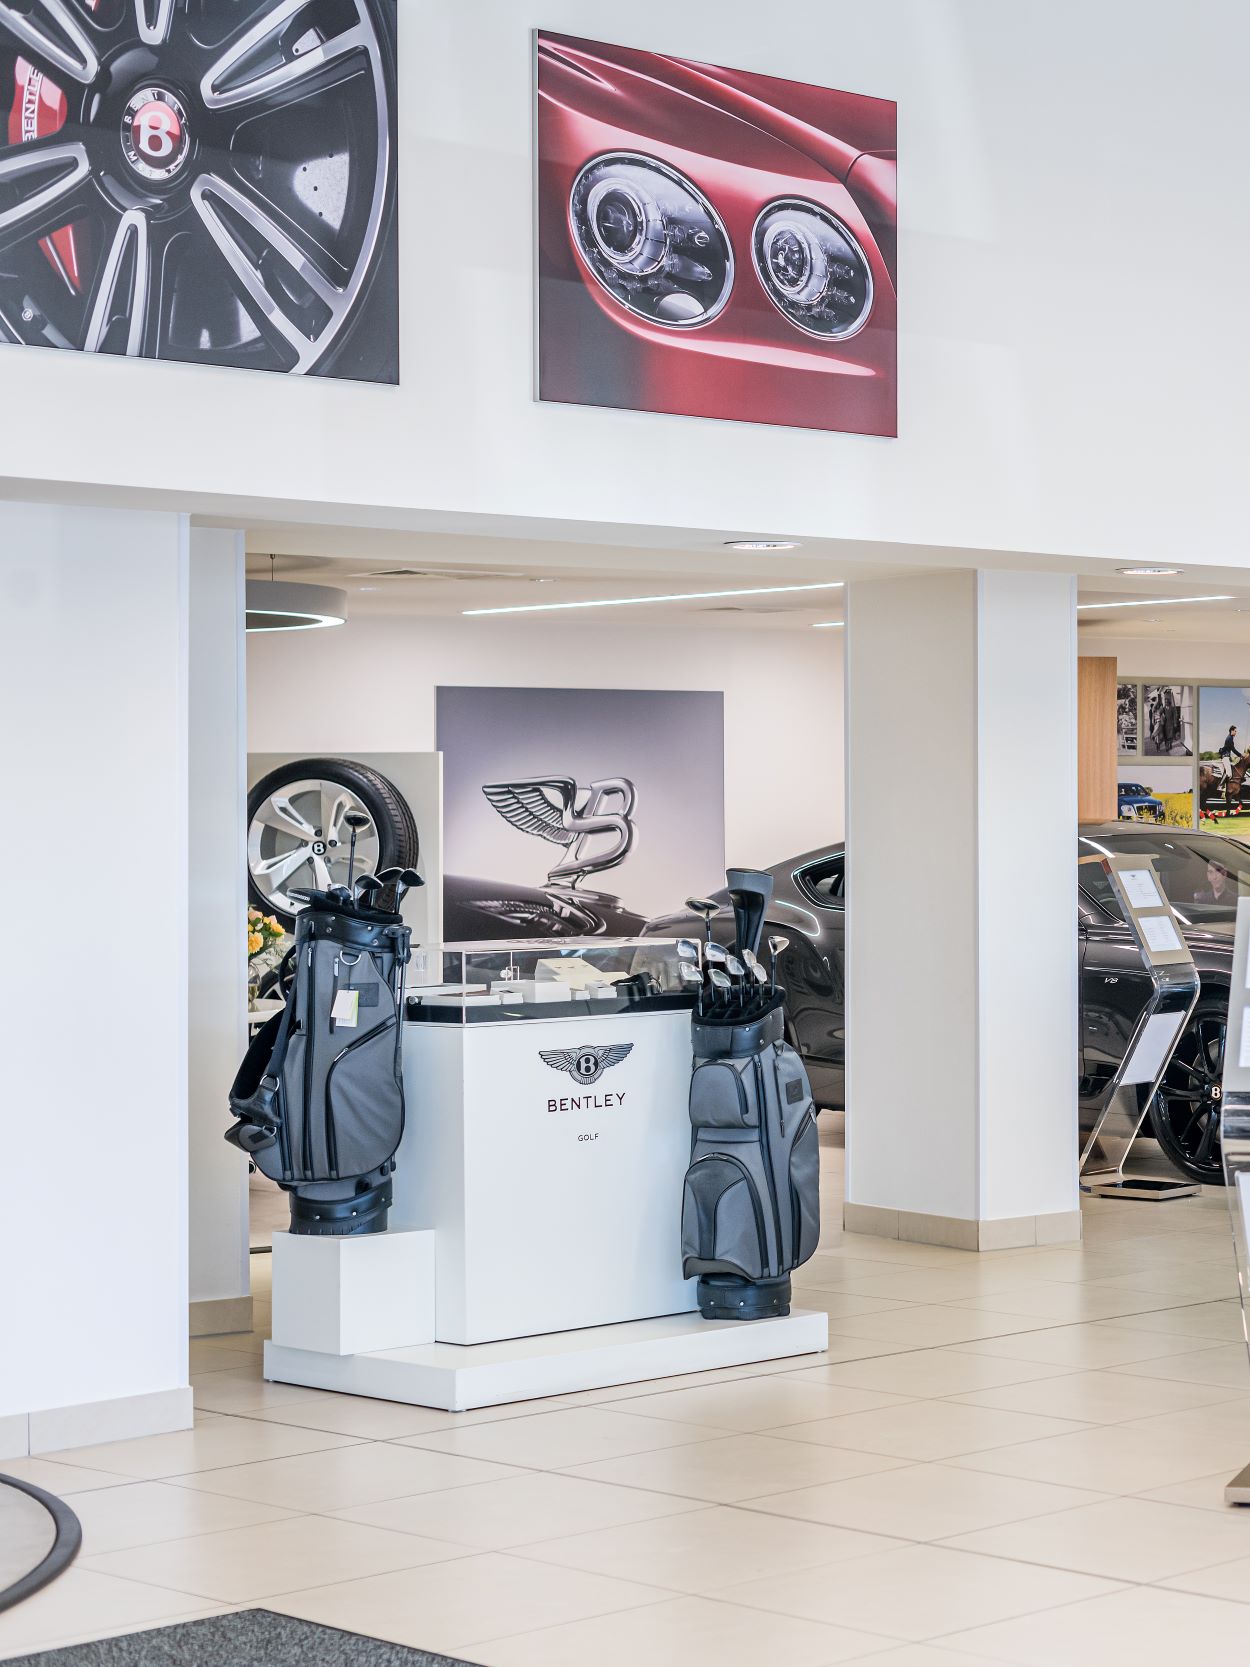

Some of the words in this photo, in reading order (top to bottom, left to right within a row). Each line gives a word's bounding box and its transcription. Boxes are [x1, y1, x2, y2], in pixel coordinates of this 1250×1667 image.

[138, 111, 173, 157] B
[547, 1092, 626, 1112] BENTLEY
[577, 1132, 600, 1142] GOLF
